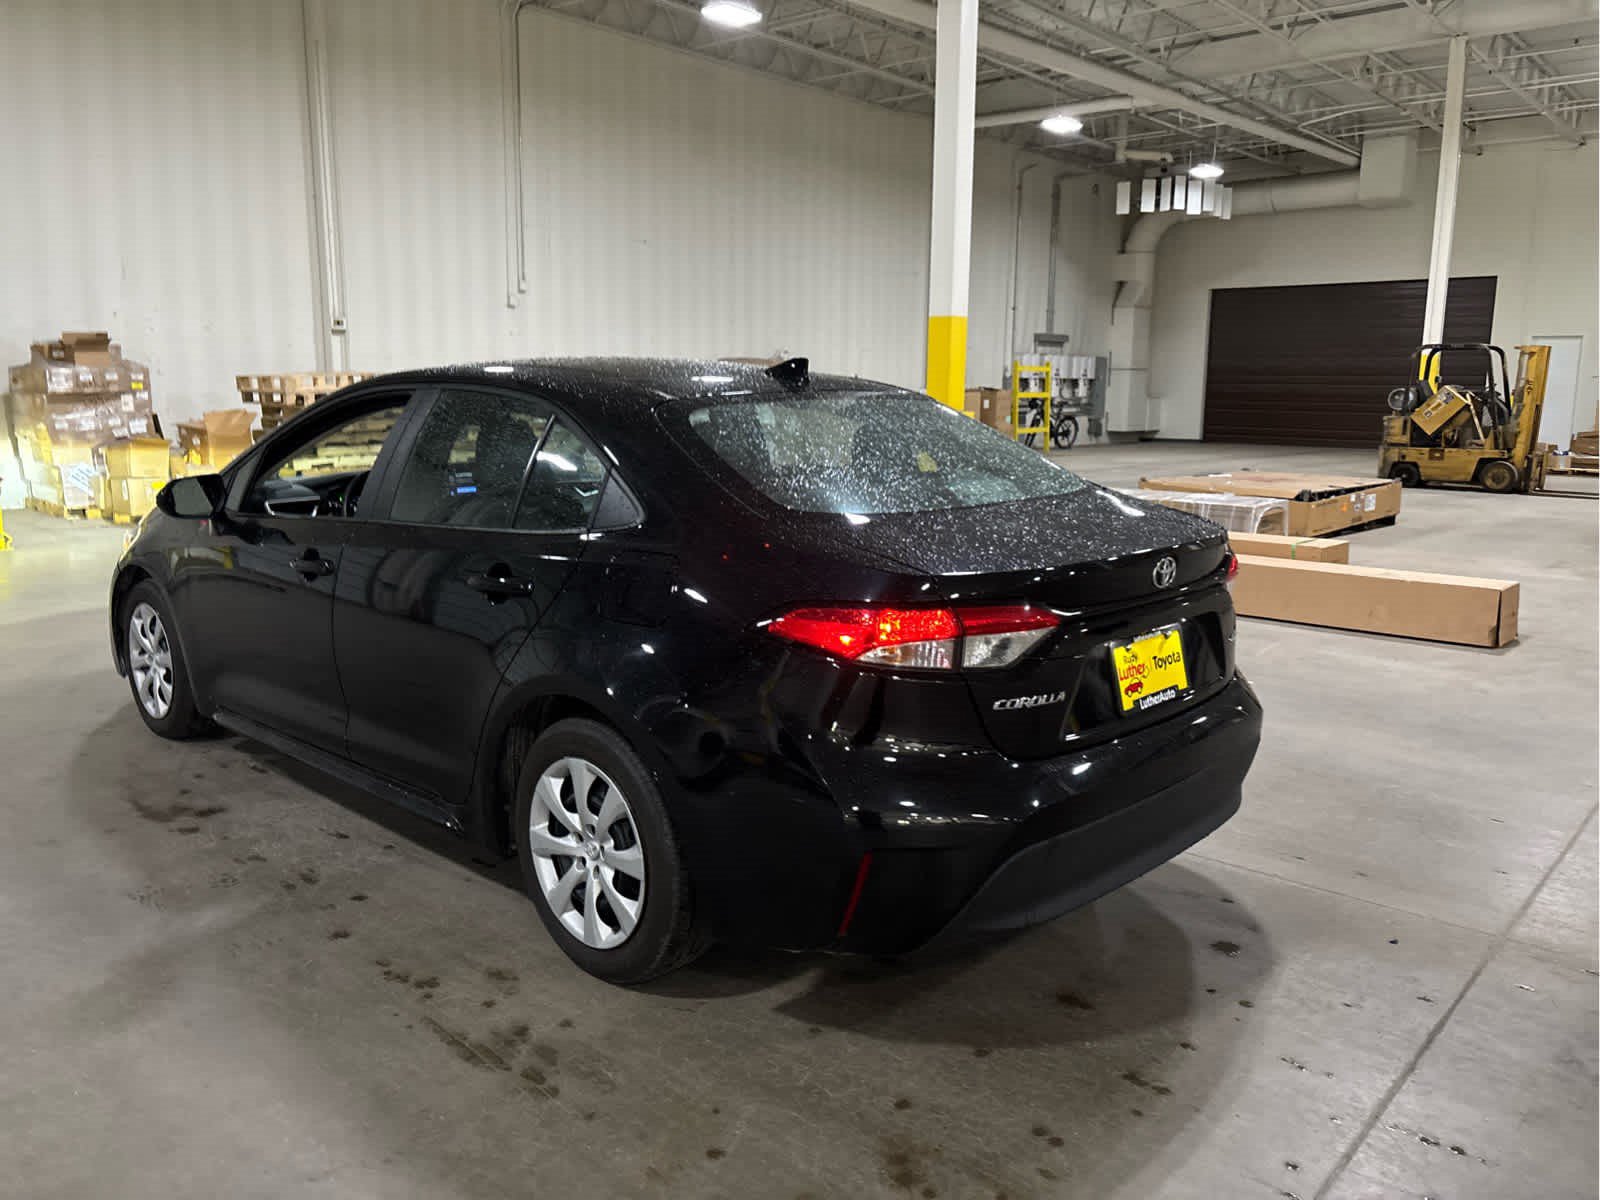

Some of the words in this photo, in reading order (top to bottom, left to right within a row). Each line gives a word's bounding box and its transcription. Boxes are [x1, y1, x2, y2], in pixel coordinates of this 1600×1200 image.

[1152, 652, 1181, 670] Toyota
[1119, 664, 1146, 681] Luther
[993, 691, 1066, 710] COROLLA
[1140, 689, 1176, 710] LutherAuto
